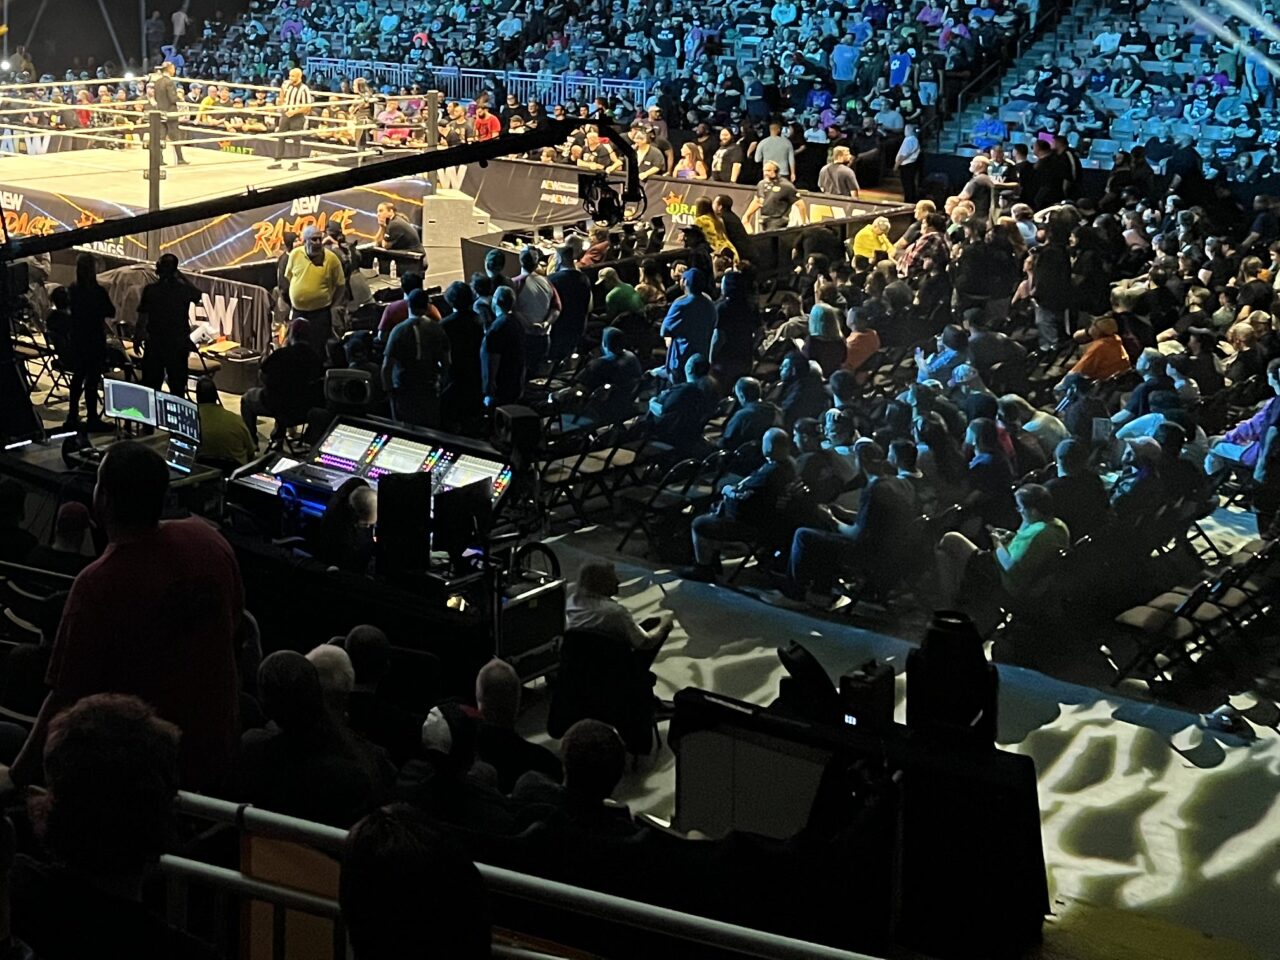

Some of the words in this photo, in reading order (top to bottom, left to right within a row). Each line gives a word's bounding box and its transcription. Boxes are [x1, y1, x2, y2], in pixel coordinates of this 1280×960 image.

[290, 195, 321, 216] AEW
[666, 202, 697, 216] DRA
[189, 293, 239, 336] EW
